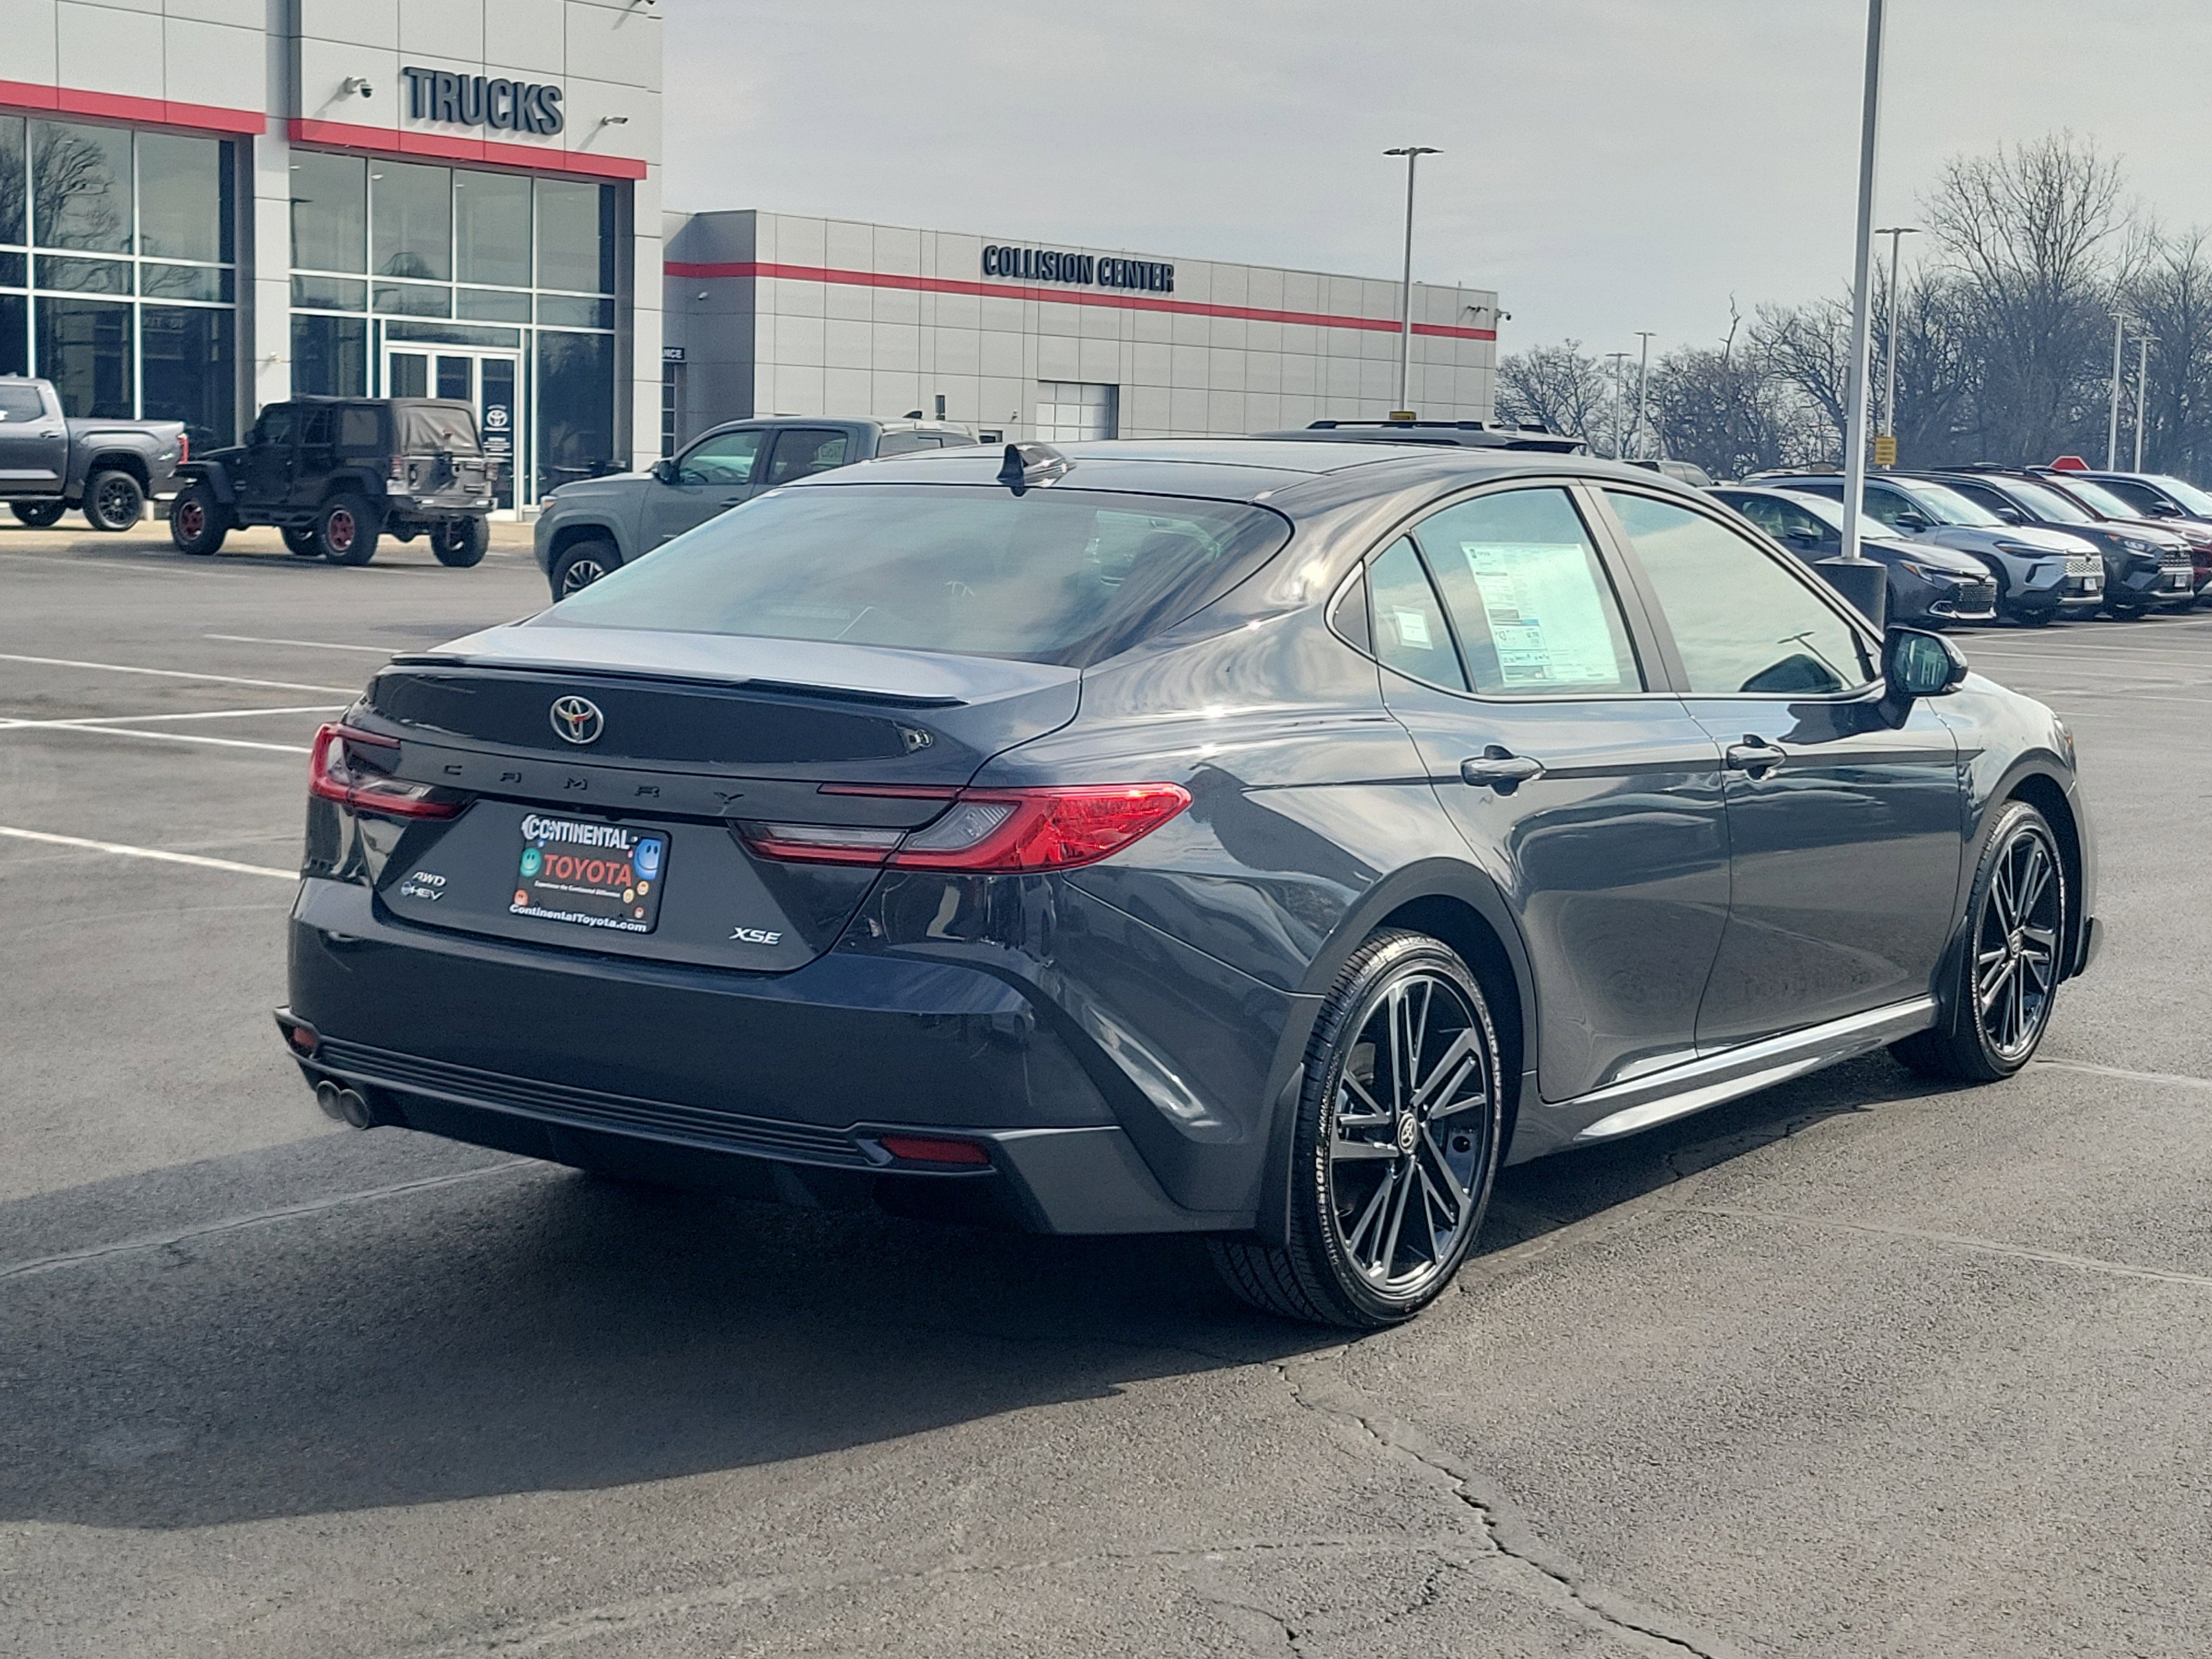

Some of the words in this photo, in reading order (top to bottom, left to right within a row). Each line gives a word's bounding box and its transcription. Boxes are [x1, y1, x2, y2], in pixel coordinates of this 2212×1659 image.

[403, 66, 564, 136] TRUCKS
[984, 245, 1094, 284] COLLISION
[1098, 257, 1175, 292] CENTER
[443, 764, 744, 804] CAMRY
[521, 814, 631, 850] CONTINENTAL
[412, 871, 447, 887] AWD
[544, 853, 633, 887] TOYOTA
[411, 885, 444, 901] HEV
[509, 904, 647, 932] ContinentalToyota.com
[728, 927, 782, 945] XSE
